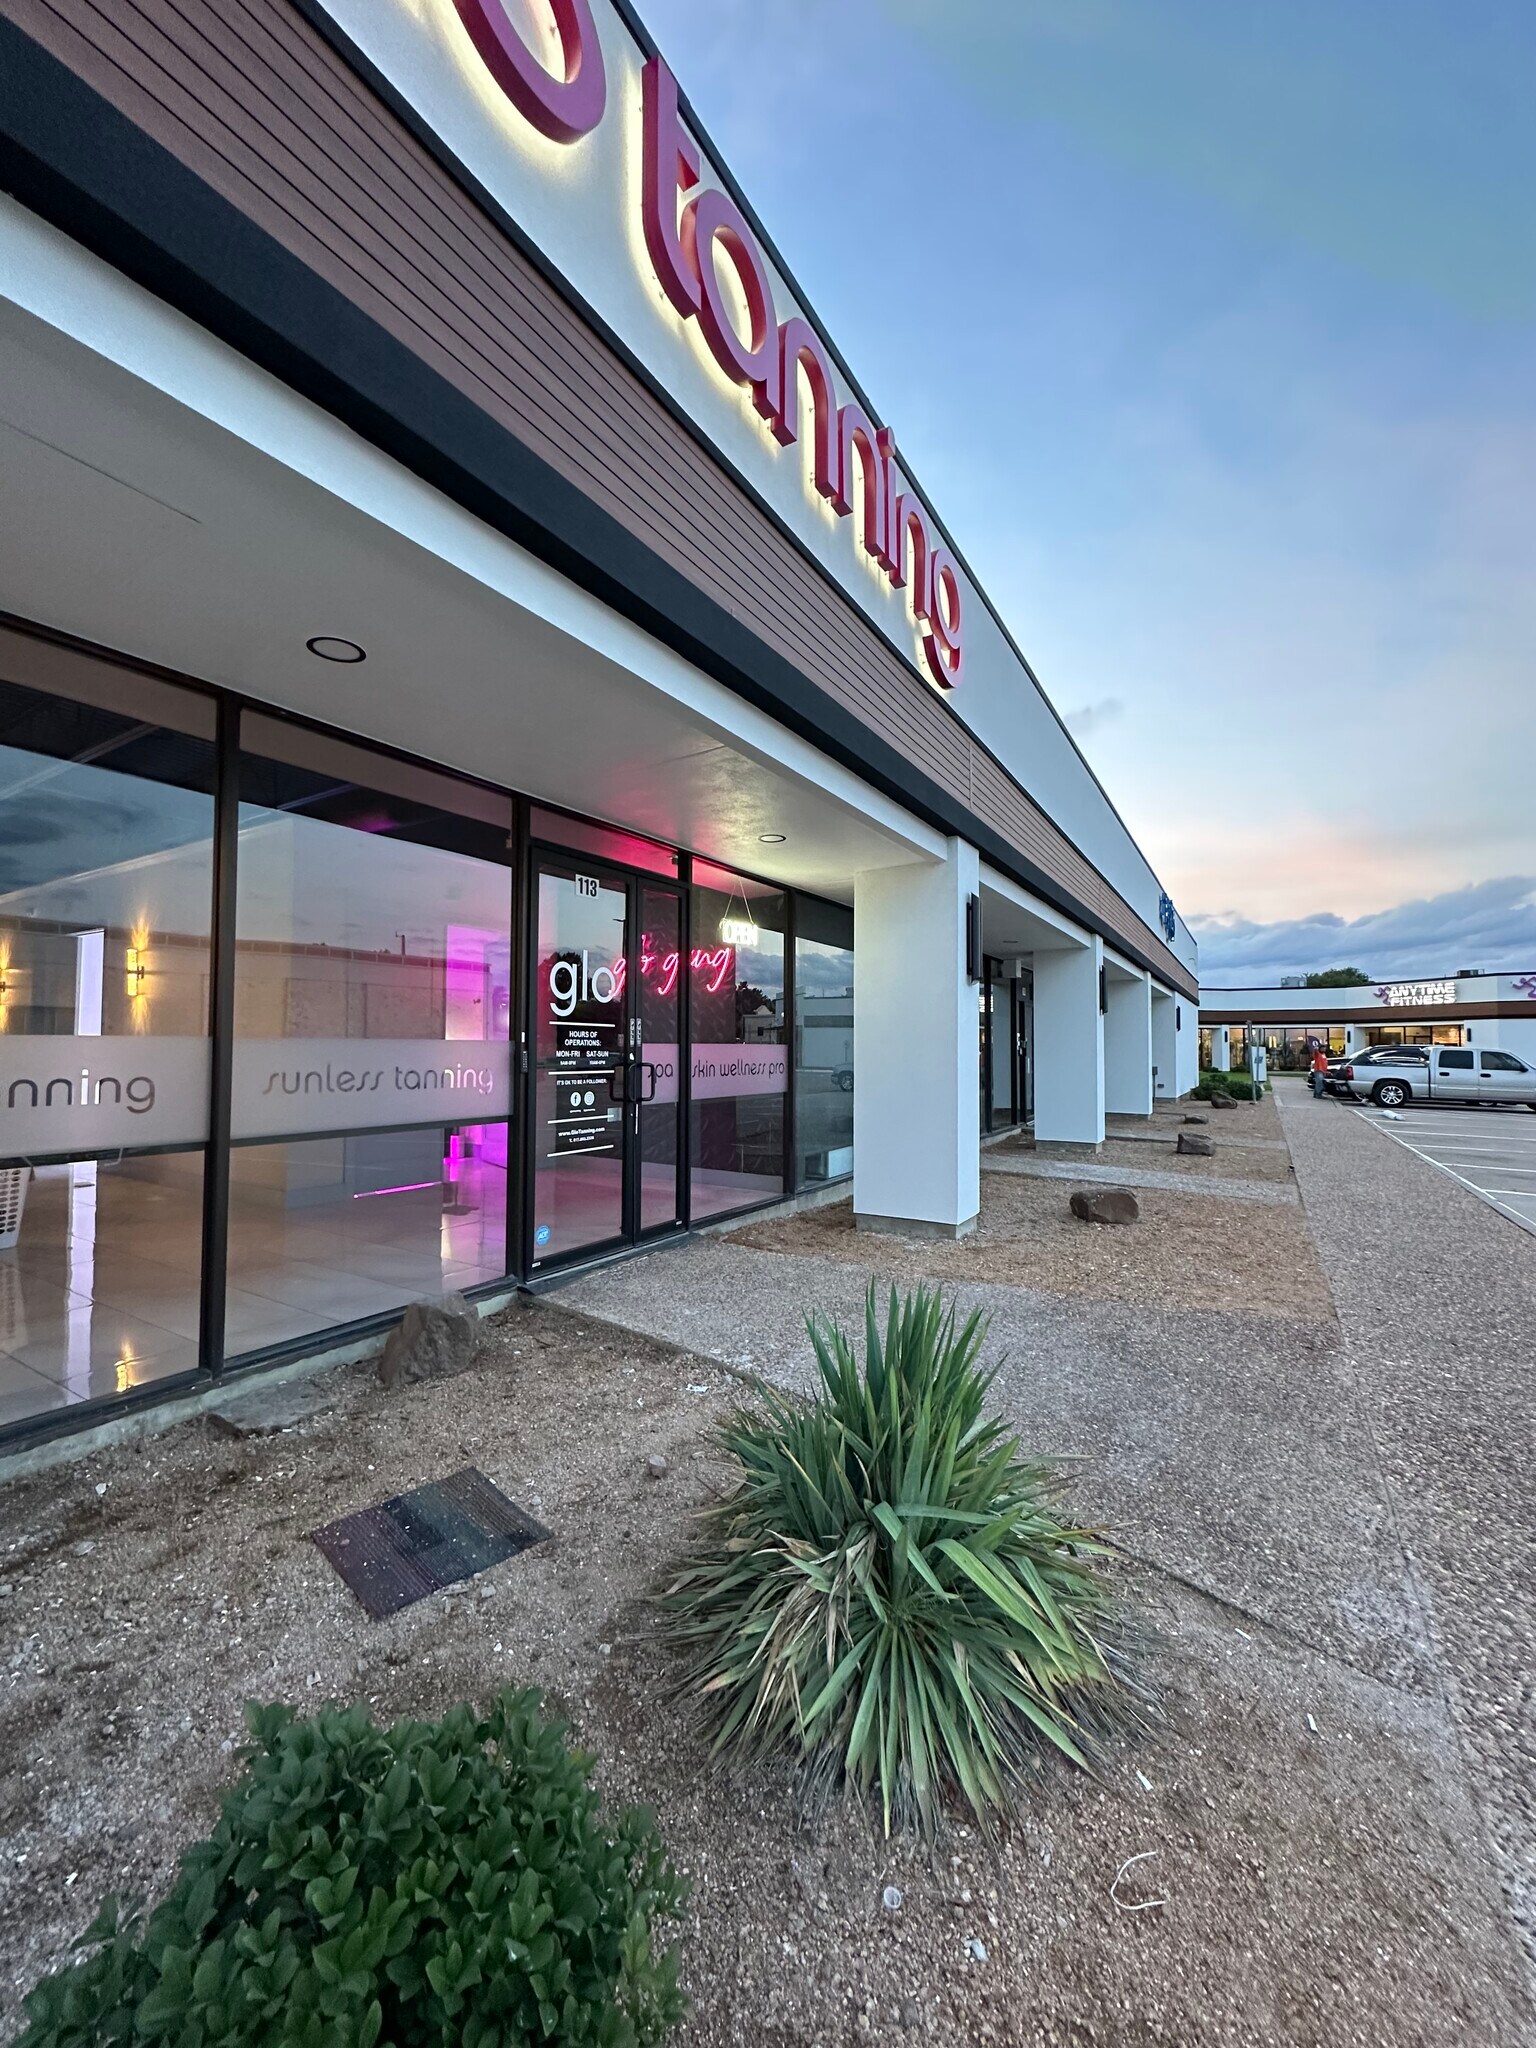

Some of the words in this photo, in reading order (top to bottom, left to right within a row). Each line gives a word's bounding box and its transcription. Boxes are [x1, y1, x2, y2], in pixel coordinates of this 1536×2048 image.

[642, 54, 964, 690] tanning
[578, 877, 598, 897] 113
[549, 949, 616, 1017] glo
[1389, 982, 1455, 997] ANYTIME
[1390, 994, 1456, 1007] FITNESS
[564, 1039, 602, 1047] OPERATIONS:
[568, 1030, 589, 1038] HOURS
[556, 1050, 581, 1058] MON-FRI
[586, 1050, 609, 1058] SAT-SUN
[691, 1059, 716, 1078] skin
[720, 1058, 766, 1077] wellness
[262, 1063, 384, 1095] sunless
[395, 1063, 494, 1095] tanning
[8, 1068, 156, 1114] nning
